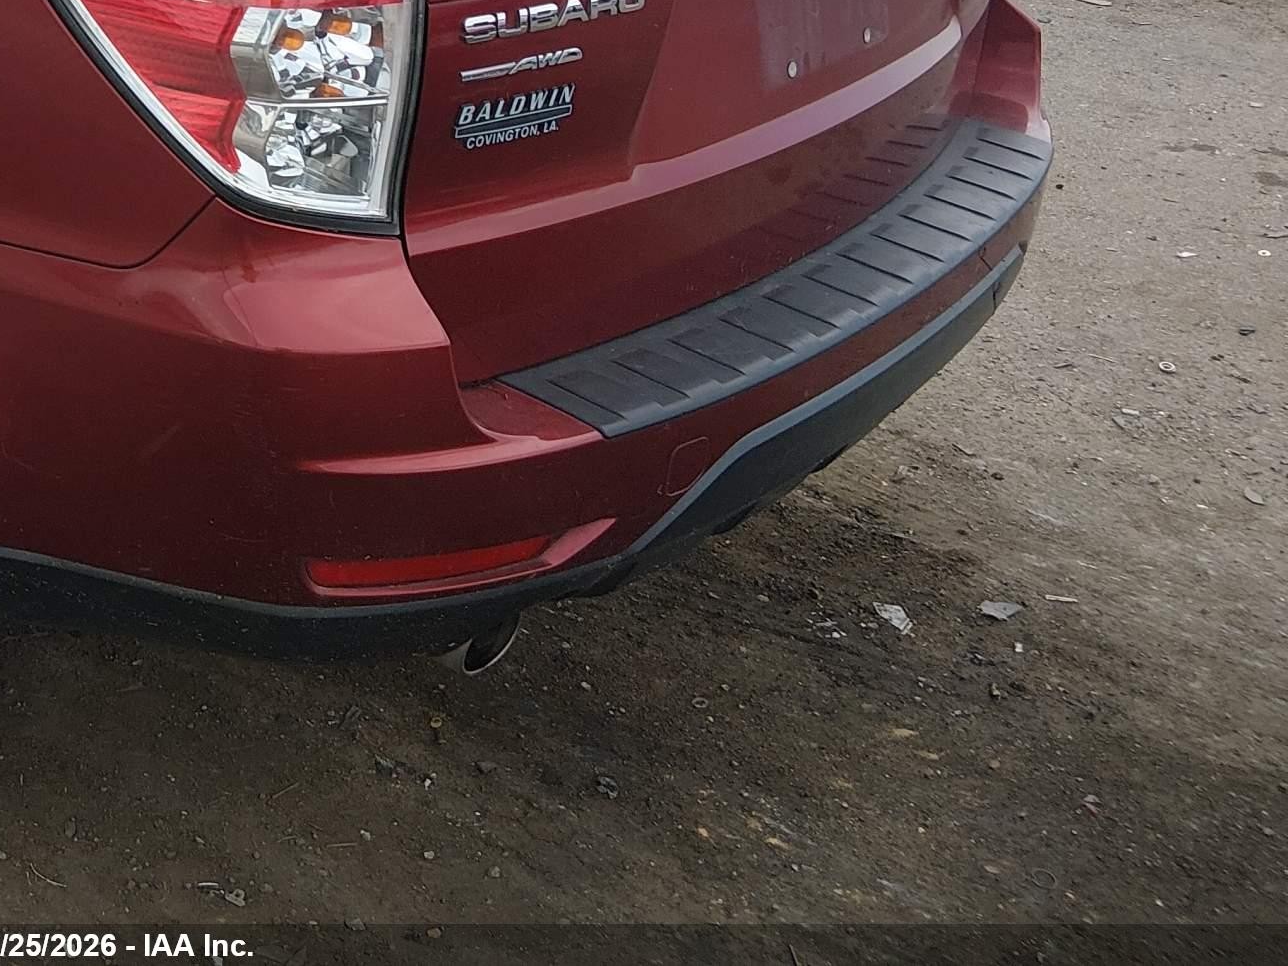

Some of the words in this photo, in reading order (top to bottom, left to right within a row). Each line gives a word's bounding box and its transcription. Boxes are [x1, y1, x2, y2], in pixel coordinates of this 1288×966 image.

[509, 47, 583, 75] AWD
[458, 83, 576, 126] BALDWIN
[466, 125, 541, 150] COVINGTON,
[543, 120, 559, 134] LA.
